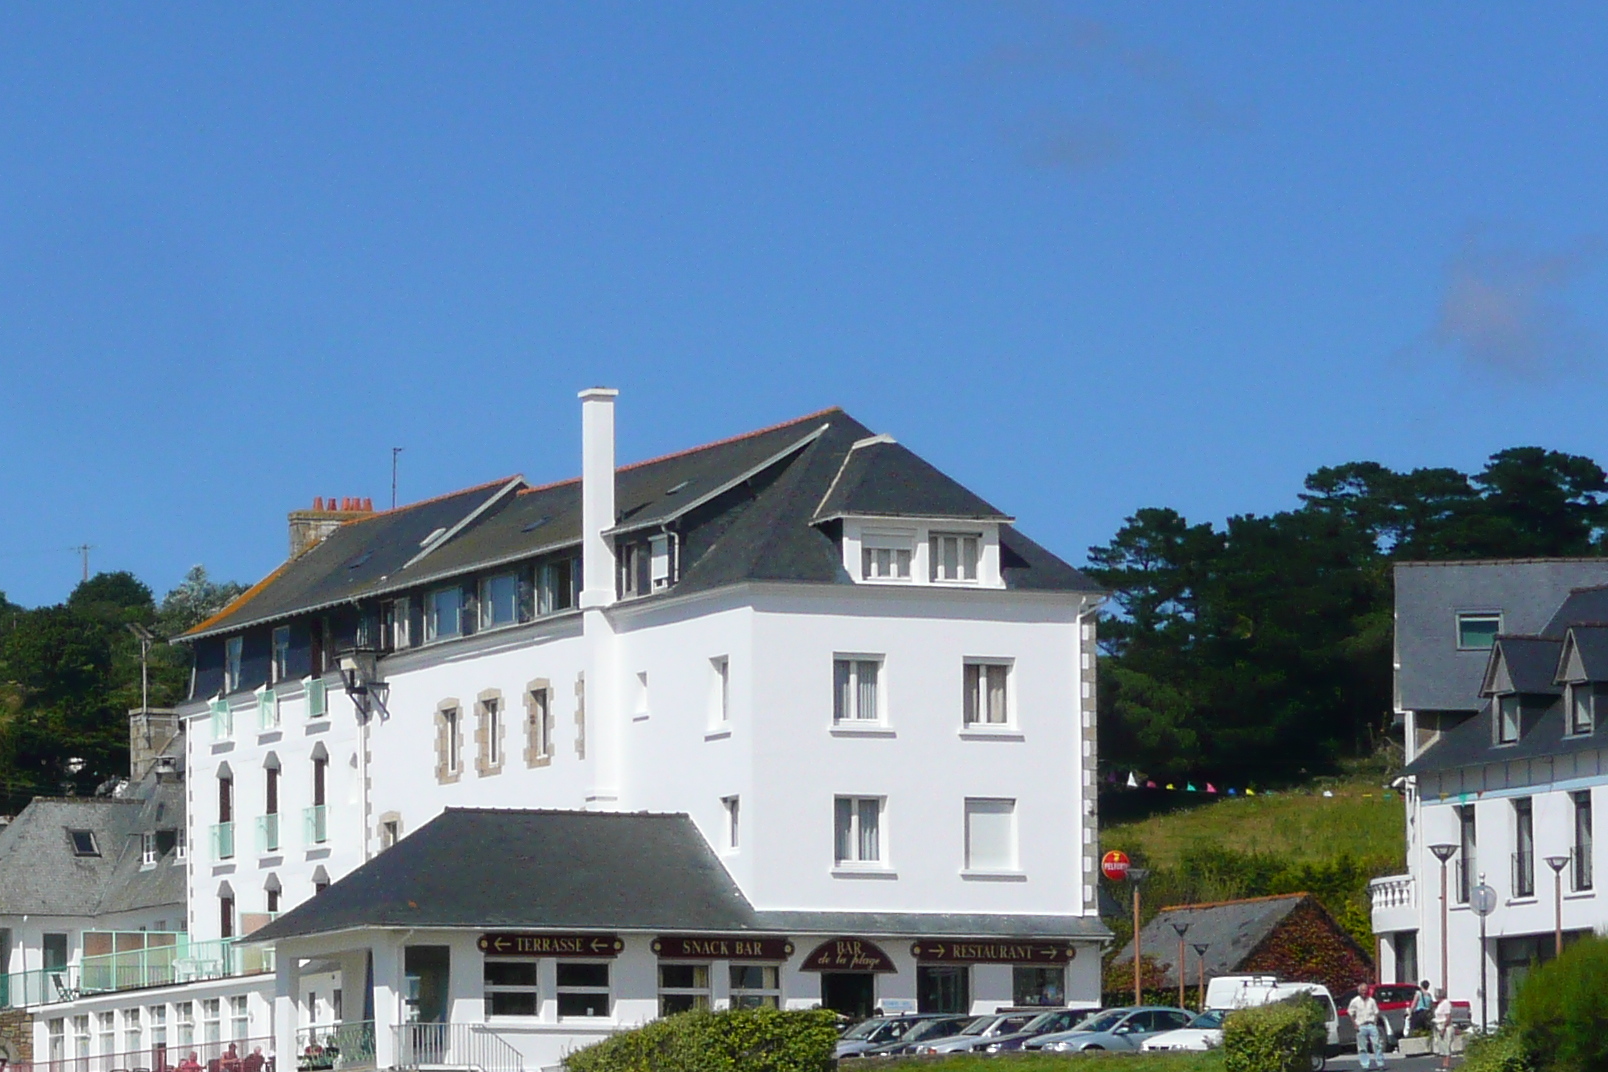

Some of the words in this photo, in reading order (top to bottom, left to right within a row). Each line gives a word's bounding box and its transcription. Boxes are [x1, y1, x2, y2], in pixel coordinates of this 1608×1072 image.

[515, 938, 584, 952] TERRASSE
[682, 940, 729, 955] SNACK
[735, 941, 763, 956] BAR
[836, 941, 862, 955] BAR
[952, 943, 1034, 960] RESTAURANT
[818, 951, 832, 965] de
[836, 953, 848, 965] la
[849, 952, 881, 970] plage
